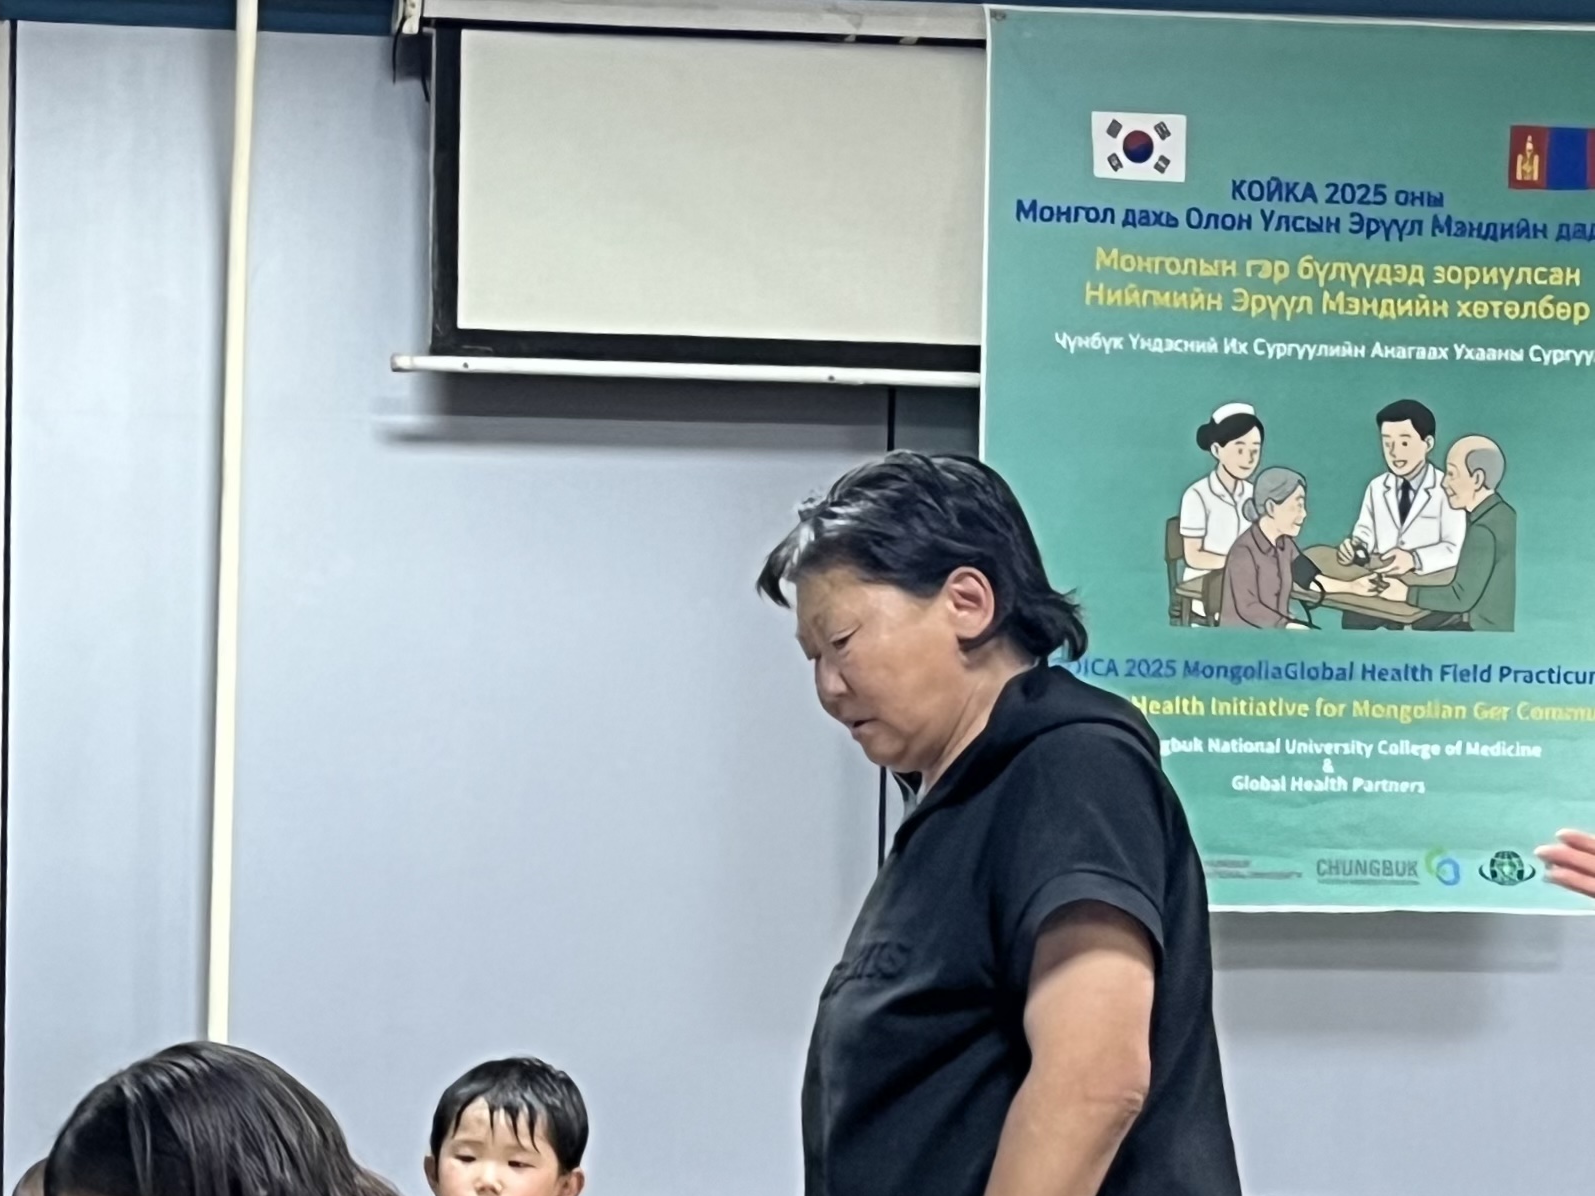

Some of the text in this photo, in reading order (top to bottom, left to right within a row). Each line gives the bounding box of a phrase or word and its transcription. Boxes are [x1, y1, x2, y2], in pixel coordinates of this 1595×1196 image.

[1231, 176, 1445, 208] КОЙКА 2025 оны
[1015, 198, 1116, 225] Монгол
[1121, 207, 1180, 229] дахь
[1185, 206, 1252, 231] Олон
[1259, 208, 1341, 234] Улсын
[1348, 212, 1424, 242] Эрүүл
[1430, 214, 1548, 242] Мэндийн
[1095, 246, 1581, 291] Монголын гэр бүлүүдэд зориулсан
[1084, 280, 1591, 326] Нийгмийн Эрүүл Мэндийн хөтөлбөр
[1128, 333, 1219, 355] Үндэсний
[1223, 337, 1249, 355] Их
[1252, 338, 1366, 361] Сургуулийн
[1370, 341, 1449, 360] Анагаах
[1453, 342, 1524, 362] Ухааны
[1528, 344, 1595, 367] Сургуу
[1124, 658, 1177, 678] 2025
[1361, 662, 1433, 682] Health
[1439, 663, 1492, 684] Field
[1210, 697, 1310, 717] Initiative
[1315, 697, 1347, 718] for
[1352, 699, 1467, 725] Mongolian
[1207, 737, 1281, 754] National
[1285, 738, 1374, 759] University
[1377, 739, 1441, 760] College
[1445, 740, 1463, 756] of
[1466, 741, 1542, 758] Medicine
[1322, 758, 1335, 774] &
[1231, 774, 1426, 794] Global Health Partners
[1316, 858, 1420, 878] CHUNGBUK
